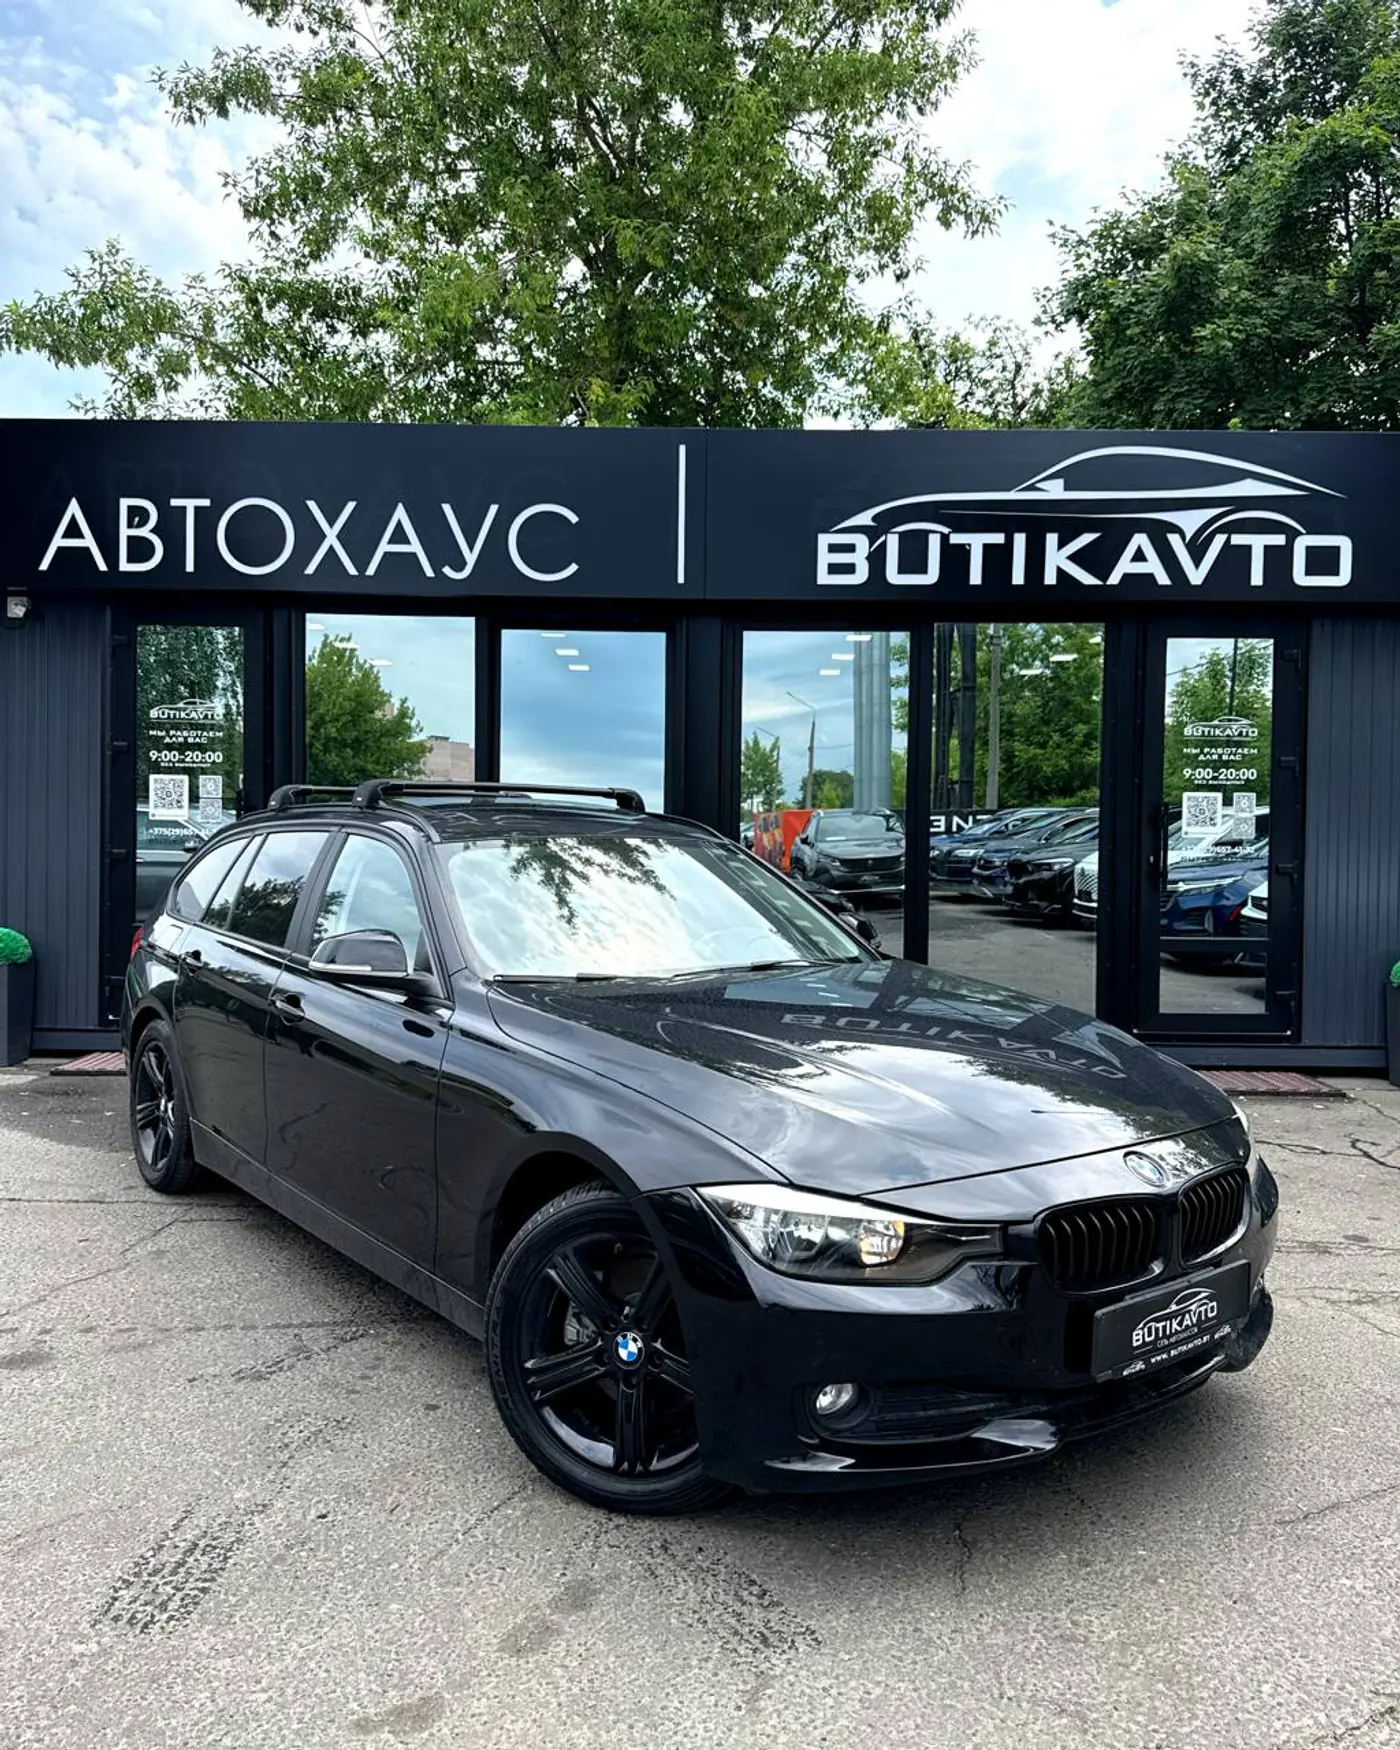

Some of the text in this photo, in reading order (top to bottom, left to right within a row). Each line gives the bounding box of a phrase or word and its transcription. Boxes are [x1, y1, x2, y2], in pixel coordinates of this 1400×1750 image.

[38, 497, 580, 583] АВТОХАУС
[816, 532, 1354, 588] BUTIKAVTO
[150, 709, 223, 719] BUTIKAVTO
[169, 730, 223, 738] РАБОТАЕМ
[1184, 727, 1258, 737] BUTIKAVTO
[149, 750, 223, 763] 9:00-20:00
[1204, 747, 1258, 755] РАБОТАЕМ
[1182, 768, 1257, 780] 9:00-20:00
[1132, 1302, 1218, 1347] BUTIKAVTO
